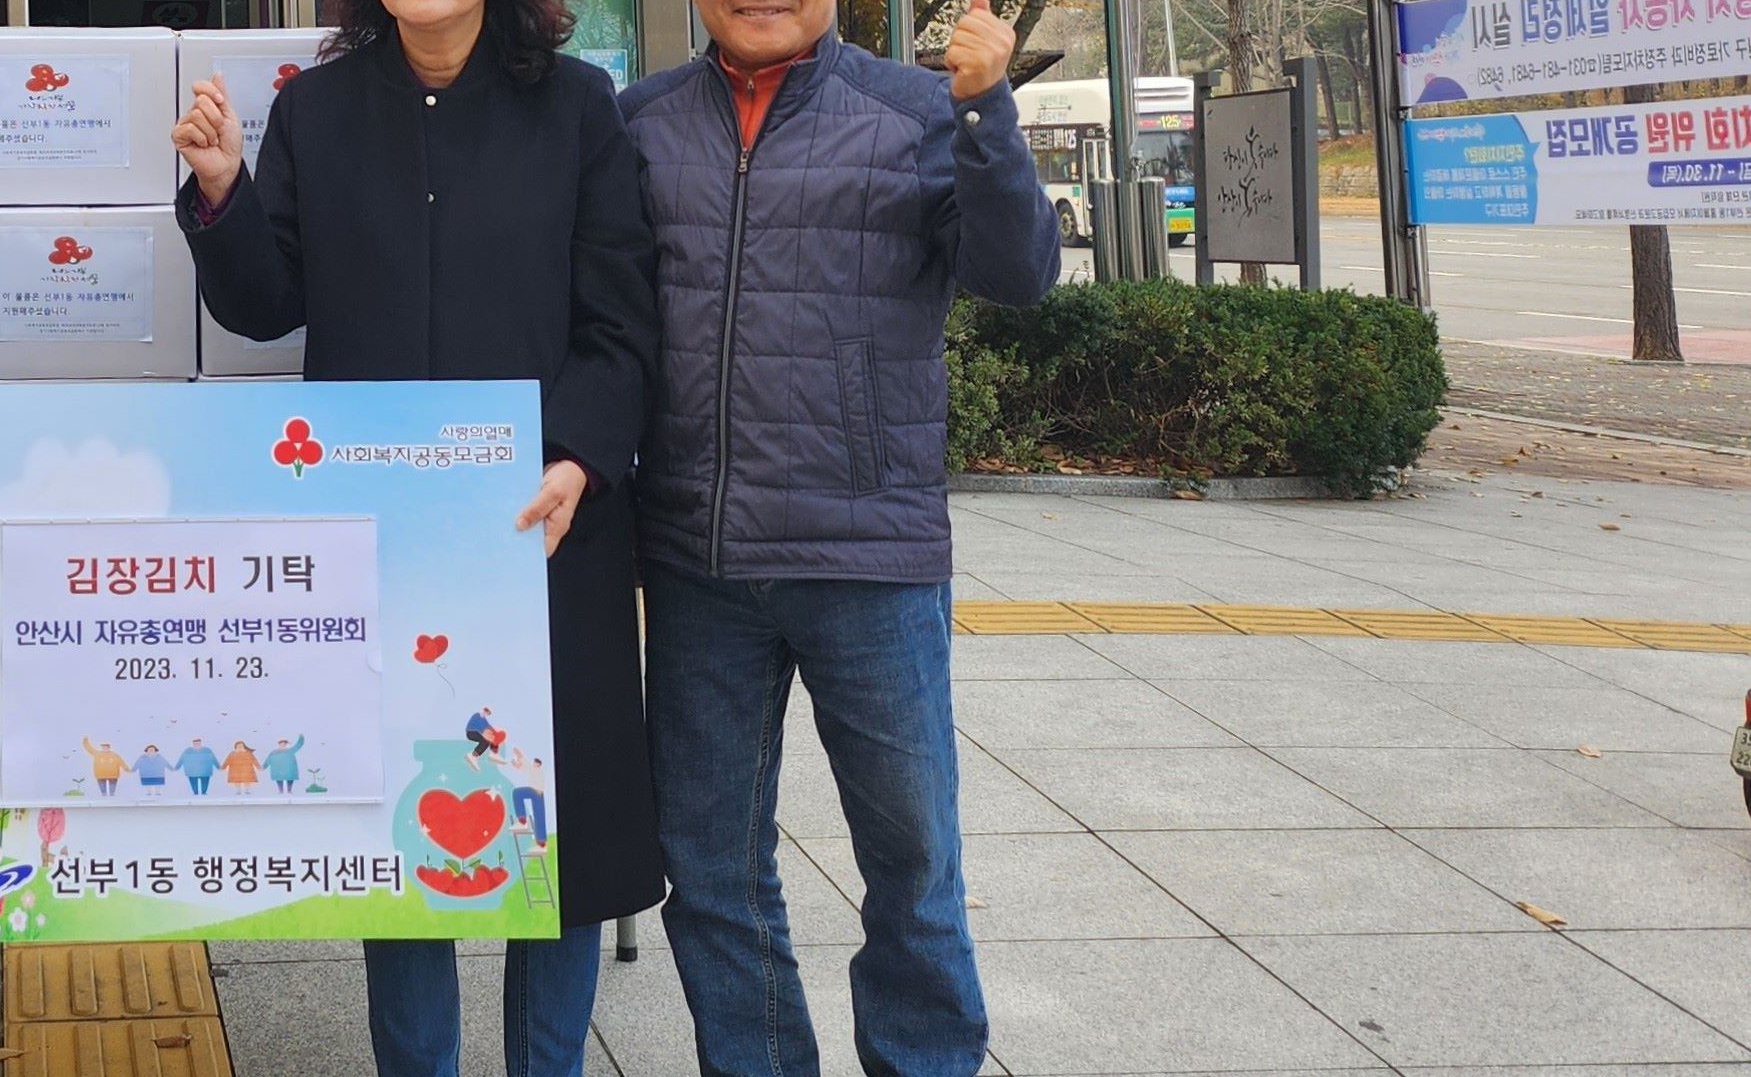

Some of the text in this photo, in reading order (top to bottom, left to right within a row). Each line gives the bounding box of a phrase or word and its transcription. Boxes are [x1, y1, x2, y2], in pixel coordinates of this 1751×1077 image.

[1159, 114, 1181, 129] 125
[440, 424, 514, 441] 사랑의열매
[329, 443, 515, 468] 사회복지공동모금회
[64, 553, 318, 597] 김장김치 기탁
[14, 616, 368, 647] 안산시 자유총연맹 선부1동위원회
[114, 656, 270, 682] 2023. 11. 23.
[48, 852, 405, 898] 선부1동 행정복지센터
